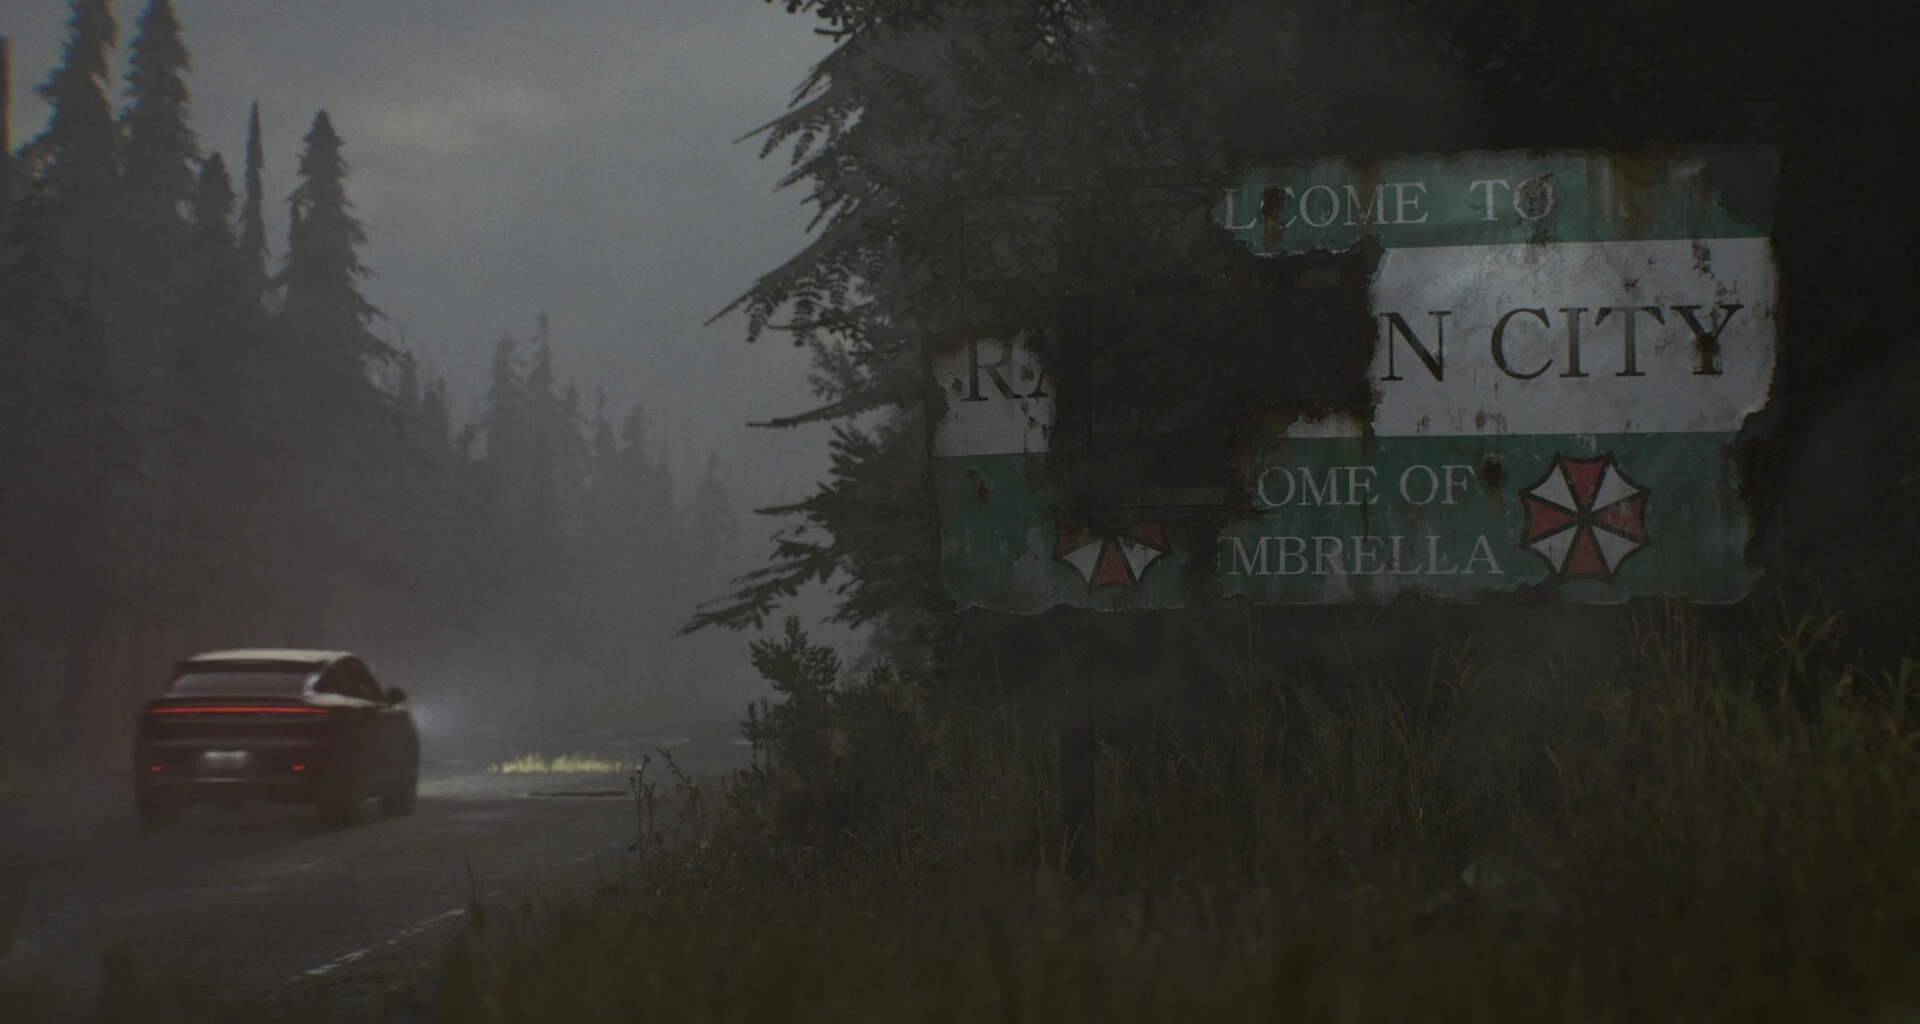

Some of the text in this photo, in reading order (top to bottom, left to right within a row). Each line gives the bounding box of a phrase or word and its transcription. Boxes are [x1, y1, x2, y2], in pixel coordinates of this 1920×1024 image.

[1468, 174, 1556, 222] TO
[1491, 304, 1744, 380] CITY
[1257, 464, 1476, 508] OME OF
[1217, 534, 1505, 577] MBRELLA
